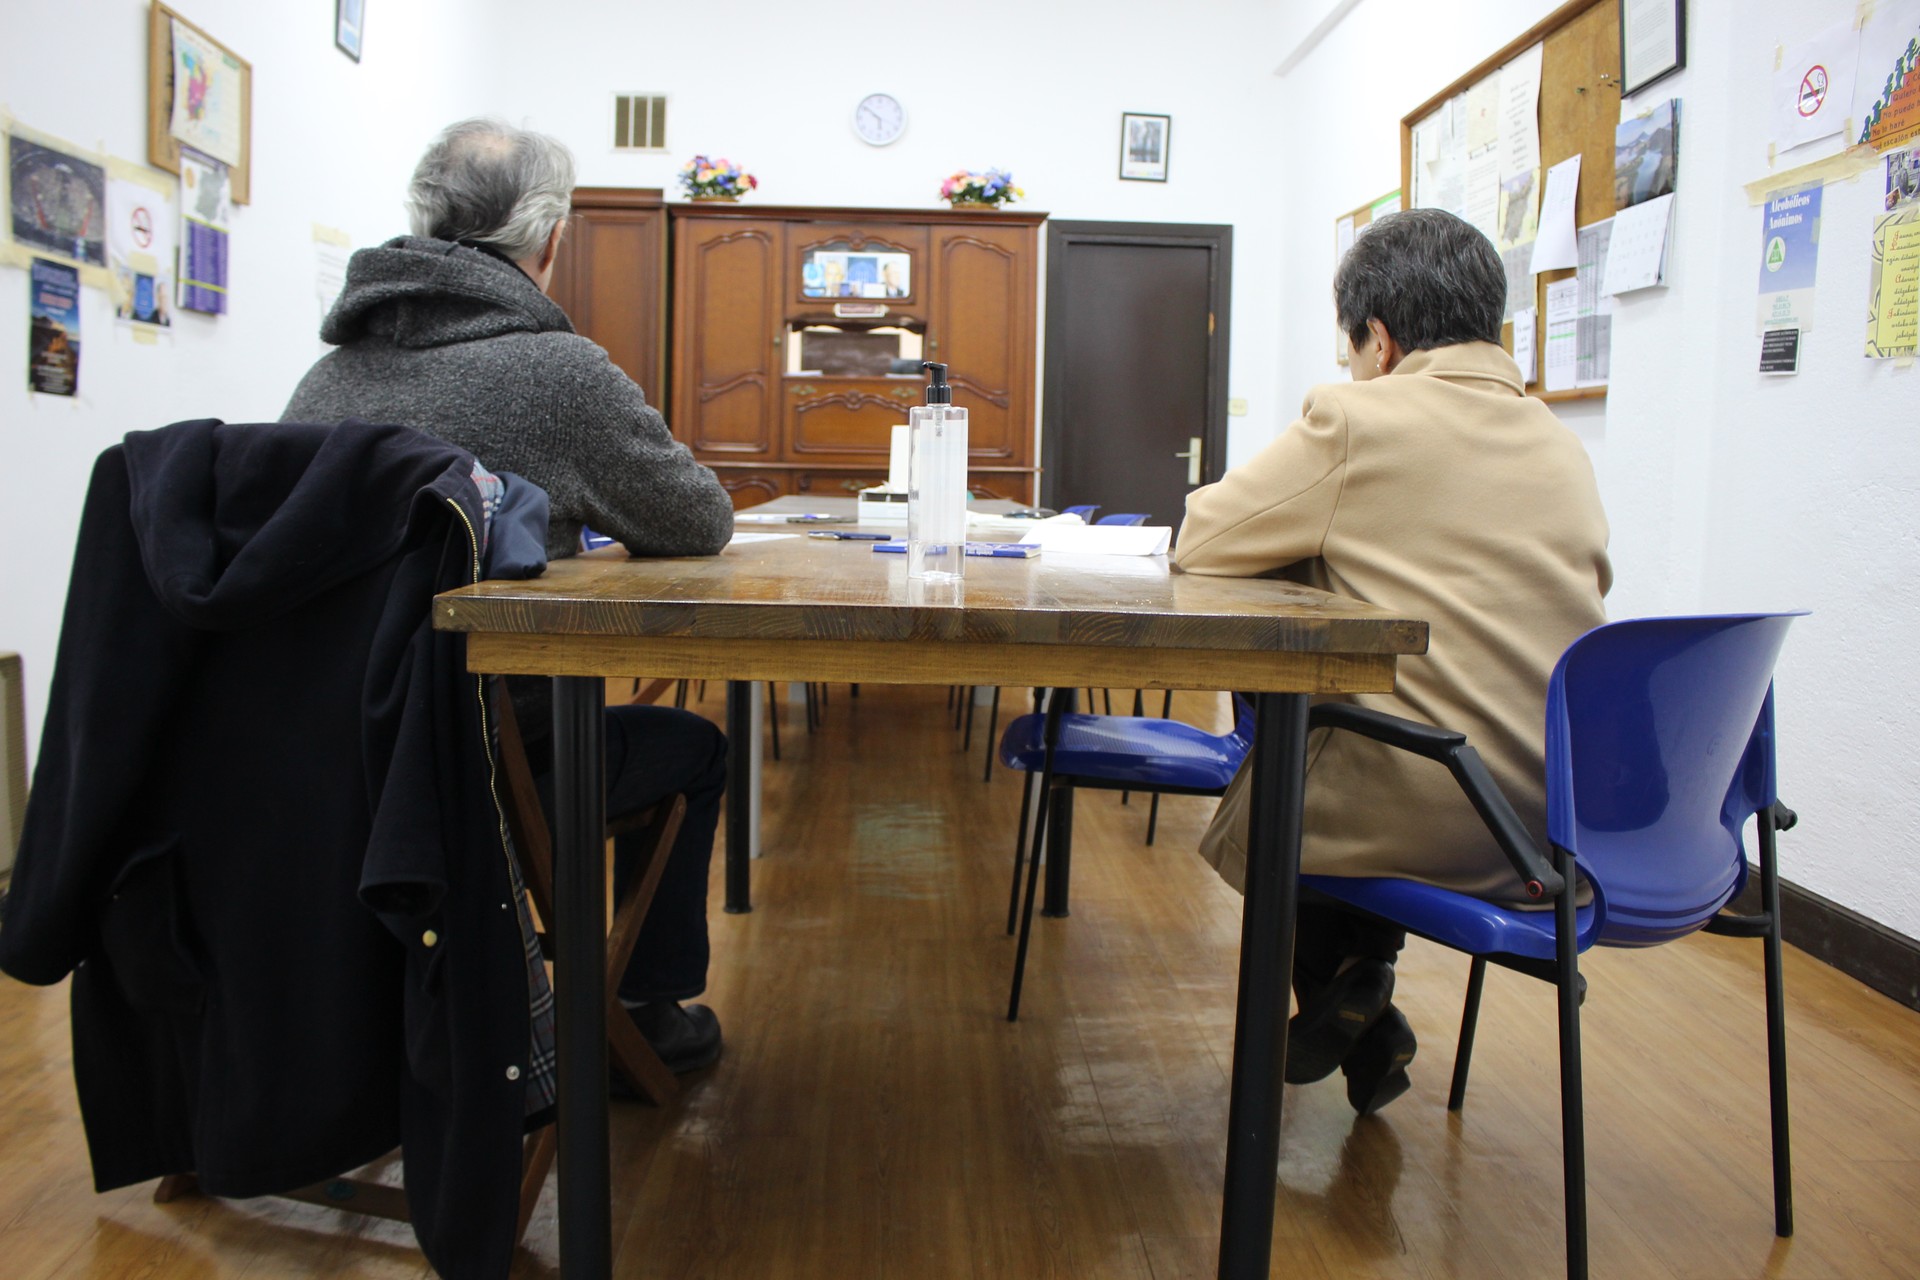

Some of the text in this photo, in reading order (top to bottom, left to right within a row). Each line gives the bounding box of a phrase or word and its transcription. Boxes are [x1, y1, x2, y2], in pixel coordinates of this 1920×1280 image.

[1893, 89, 1917, 101] Quiero
[1883, 110, 1892, 119] No
[1894, 102, 1915, 118] puedo
[1872, 127, 1881, 137] No
[1889, 120, 1905, 131] haré
[1884, 134, 1909, 146] escalón
[1770, 194, 1811, 213] Alcohólicos
[1769, 213, 1803, 230] Anónimos
